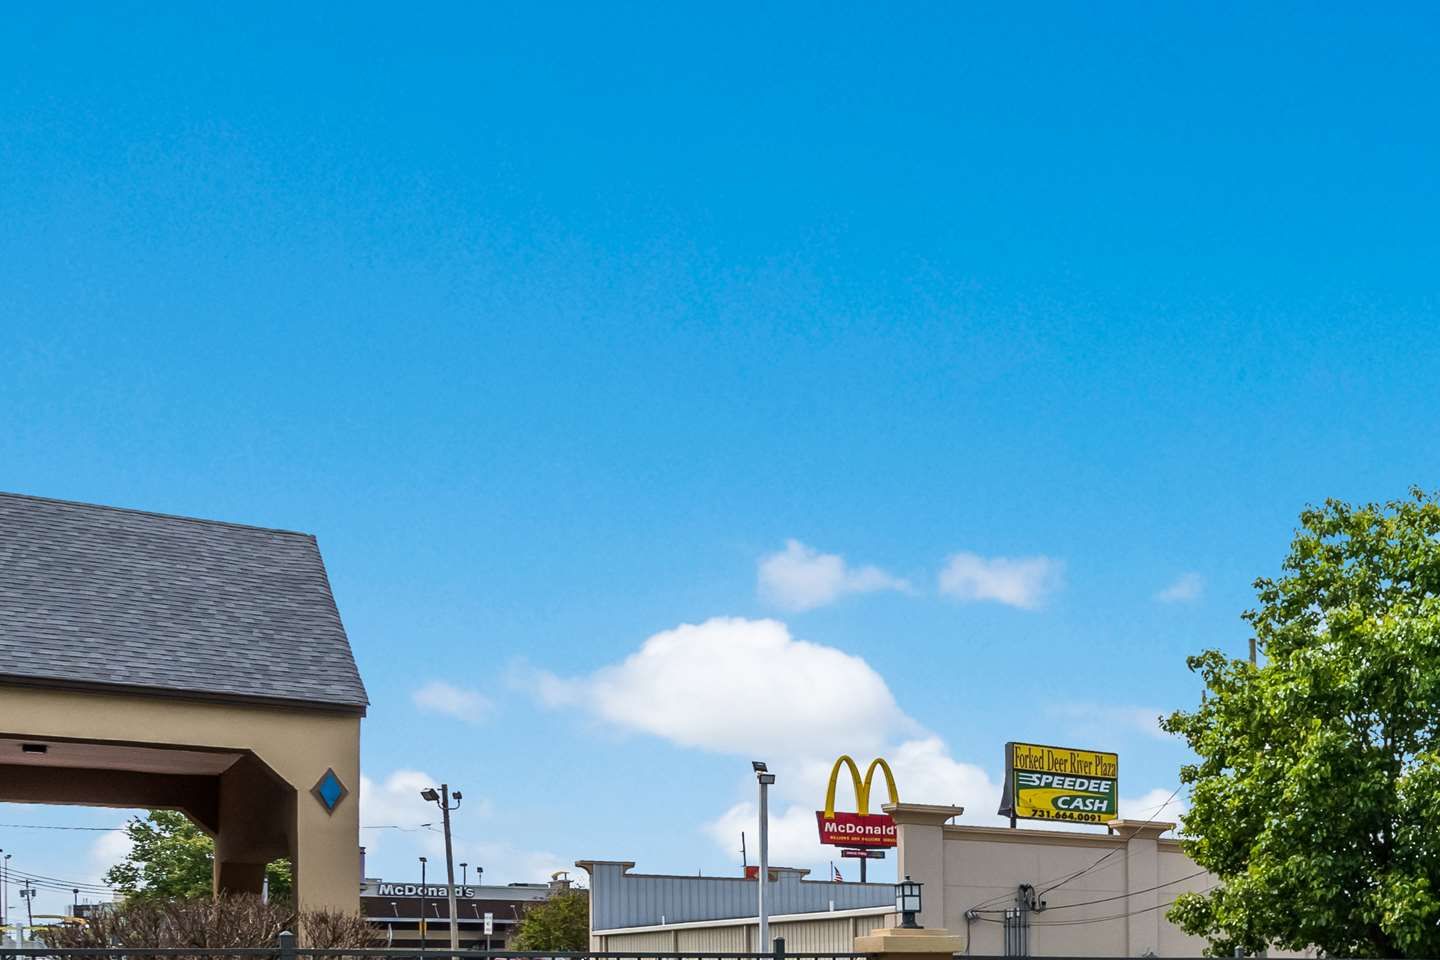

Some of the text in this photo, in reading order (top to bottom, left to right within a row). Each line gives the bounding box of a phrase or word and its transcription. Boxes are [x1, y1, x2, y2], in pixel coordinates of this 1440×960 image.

[1014, 746, 1116, 777] Forked Deer River Plaza
[1026, 773, 1111, 793] SPEEDEE
[1057, 796, 1108, 812] CASH
[1031, 809, 1102, 822] 731.664.0091
[824, 822, 897, 835] McDonald'
[378, 884, 476, 897] McDonad's
